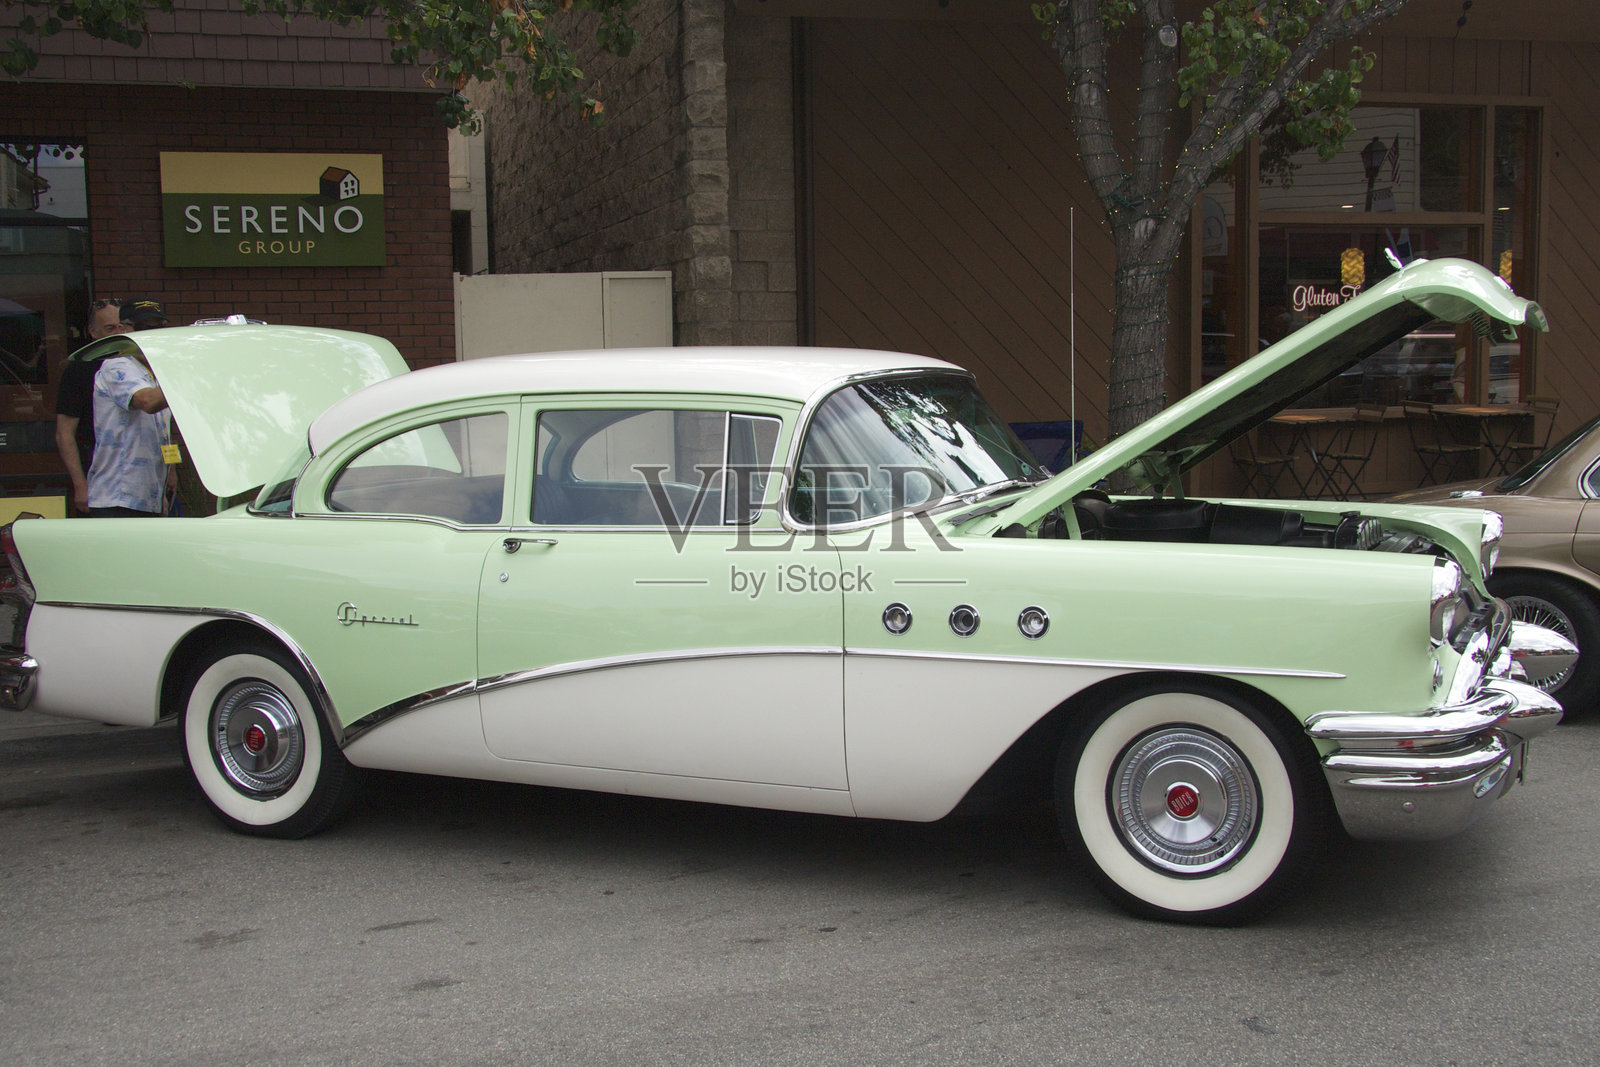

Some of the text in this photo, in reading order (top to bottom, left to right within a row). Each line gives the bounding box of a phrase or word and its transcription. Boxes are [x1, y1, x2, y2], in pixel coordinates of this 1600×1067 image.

[184, 205, 364, 234] SERENO
[238, 240, 316, 254] GROUP
[1293, 285, 1340, 312] Gluten
